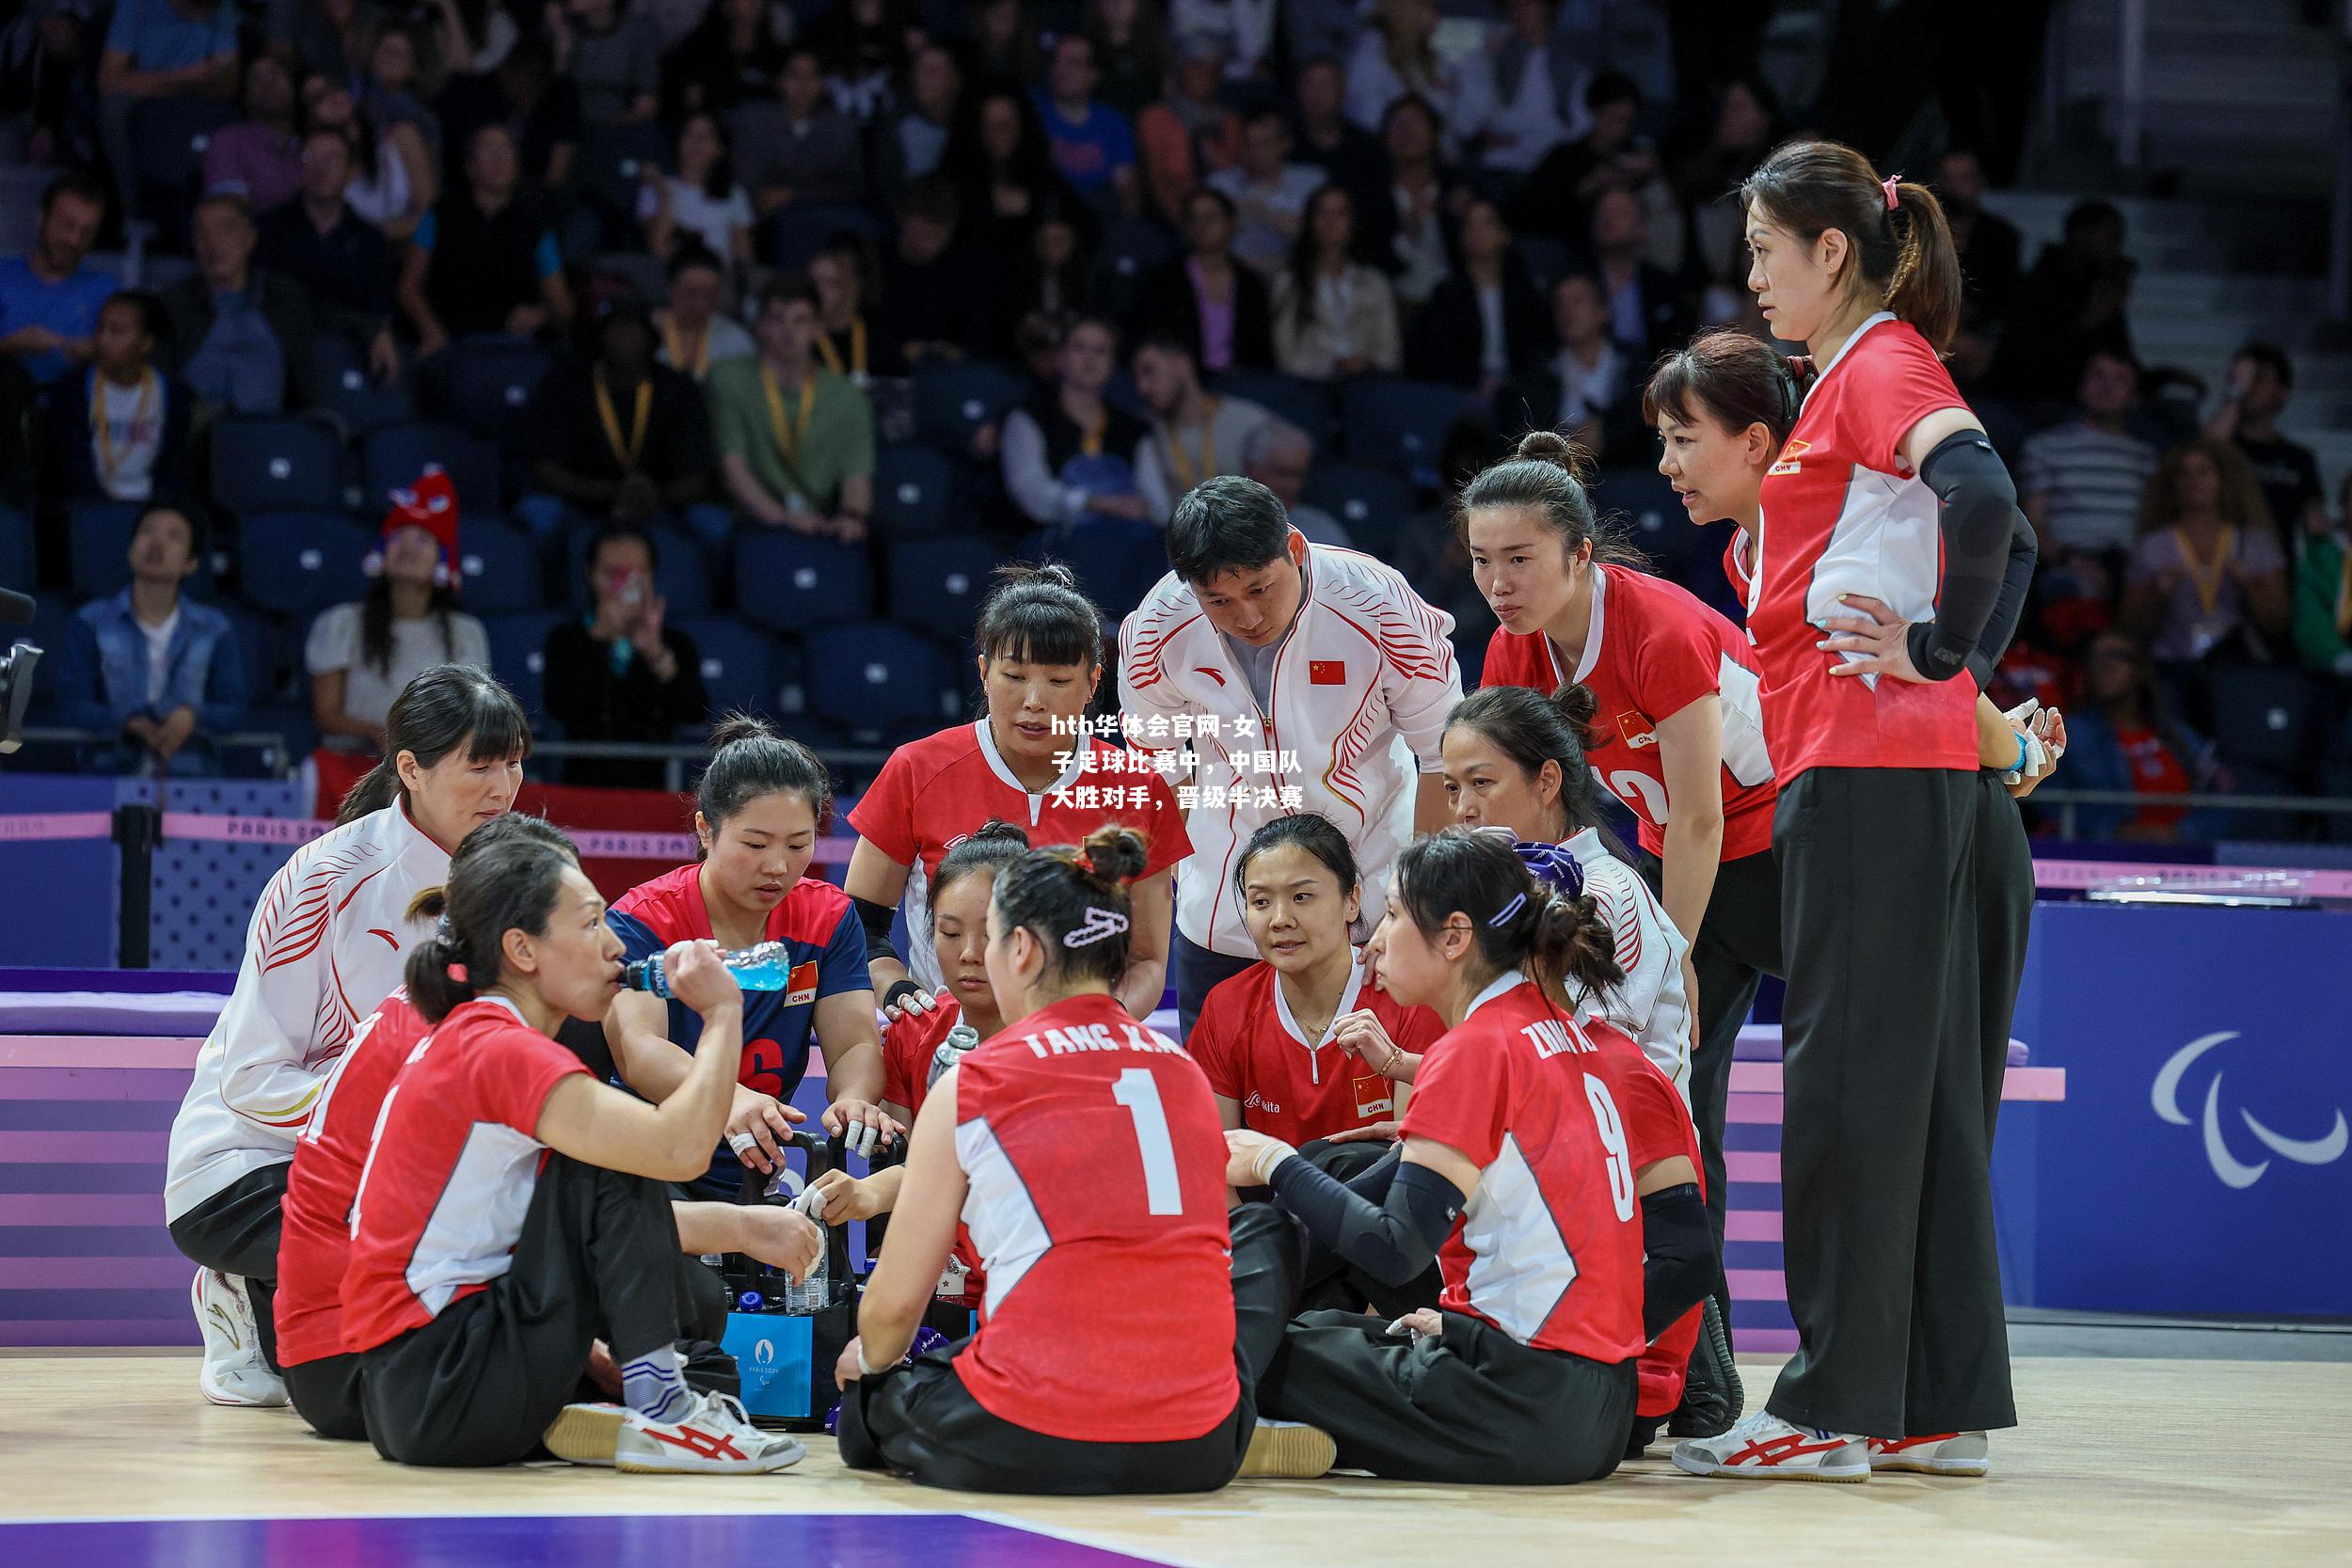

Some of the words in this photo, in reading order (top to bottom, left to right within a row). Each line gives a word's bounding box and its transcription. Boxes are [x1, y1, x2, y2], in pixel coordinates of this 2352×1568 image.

[1774, 464, 1792, 472] CHN
[227, 820, 288, 838] PARIS
[791, 992, 810, 1003] CHN
[1023, 1022, 1120, 1060] TANG
[1367, 1102, 1385, 1114] CHN
[1110, 1067, 1184, 1216] 1
[1582, 1071, 1635, 1223] 9
